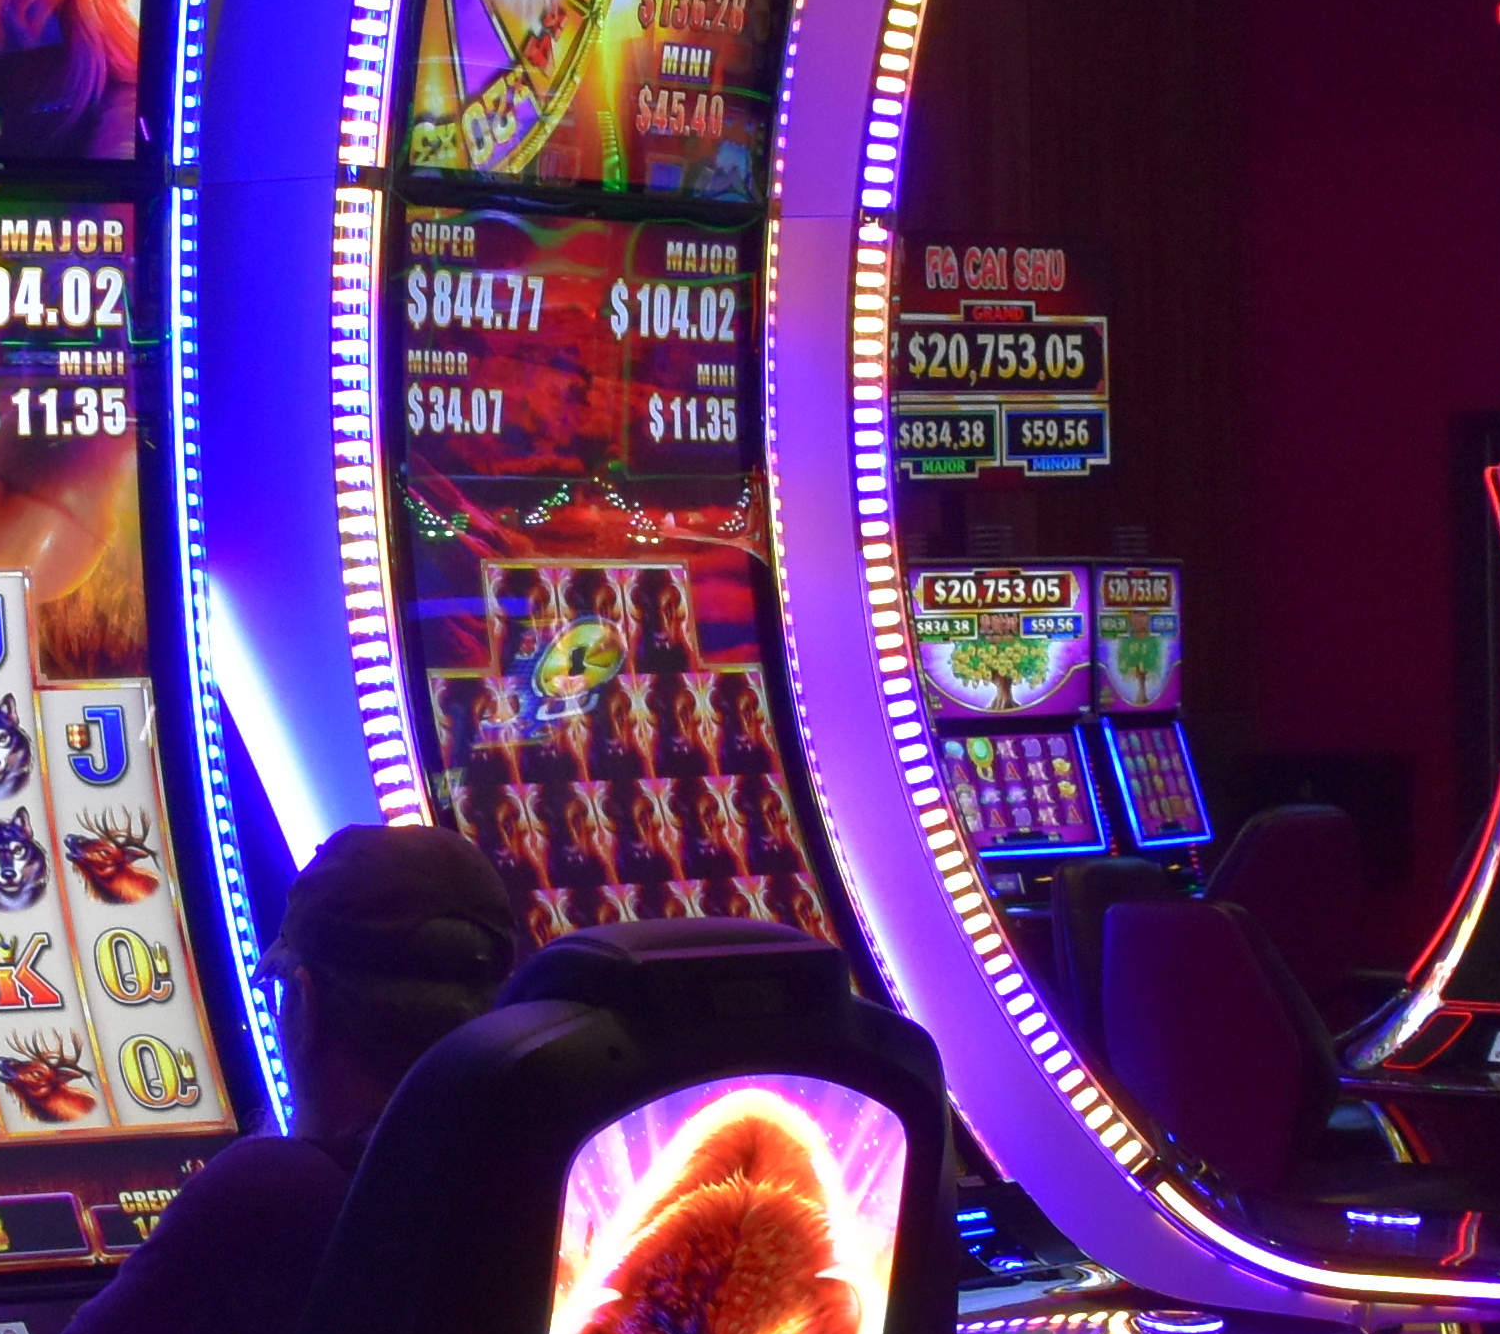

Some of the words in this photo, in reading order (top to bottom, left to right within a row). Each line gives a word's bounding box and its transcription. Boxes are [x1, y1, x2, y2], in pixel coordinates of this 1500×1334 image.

[660, 45, 714, 77] MINI
[635, 85, 724, 136] $45.40
[0, 219, 124, 255] MAJOR
[410, 221, 476, 258] SUPER
[666, 242, 737, 275] MAJOR
[926, 246, 958, 289] FA
[964, 247, 1008, 290] CAI
[1014, 248, 1066, 292] SHU
[972, 306, 1025, 322] GRAND
[58, 351, 125, 377] MINI
[408, 349, 469, 375] MINOR
[697, 364, 736, 387] MINI
[908, 332, 1085, 387] $20,753.05
[899, 421, 985, 449] $834.38
[1022, 420, 1089, 447] $59.56
[922, 461, 966, 473] MAJOR
[1033, 458, 1082, 471] MINOR
[934, 578, 1061, 608] $20,753.05
[916, 619, 970, 634] $834.38
[1031, 618, 1074, 633] $59.56
